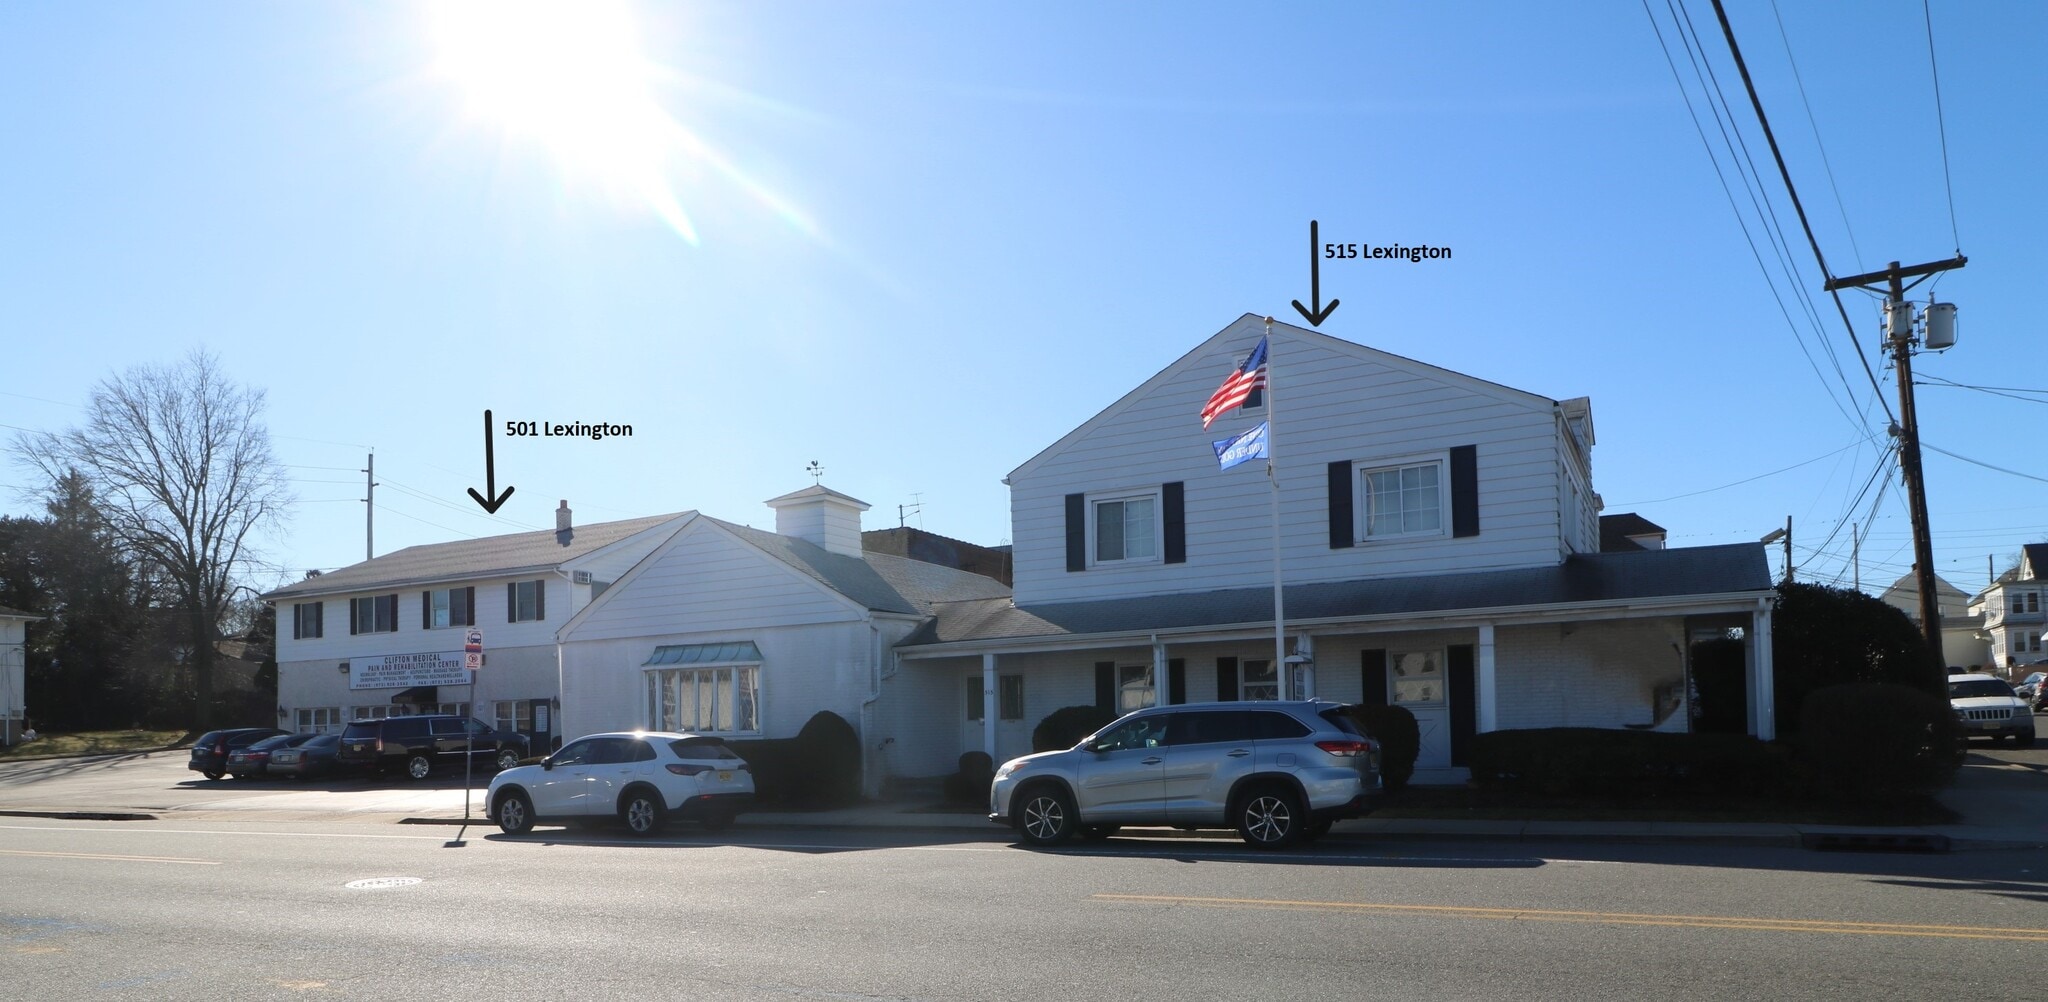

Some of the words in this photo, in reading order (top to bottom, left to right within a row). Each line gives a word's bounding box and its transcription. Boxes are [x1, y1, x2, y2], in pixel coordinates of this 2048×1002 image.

[384, 655, 410, 664] CLIFTON
[412, 653, 441, 662] MEDICAL
[394, 661, 436, 671] REHABILITATION
[438, 660, 459, 668] CENTER
